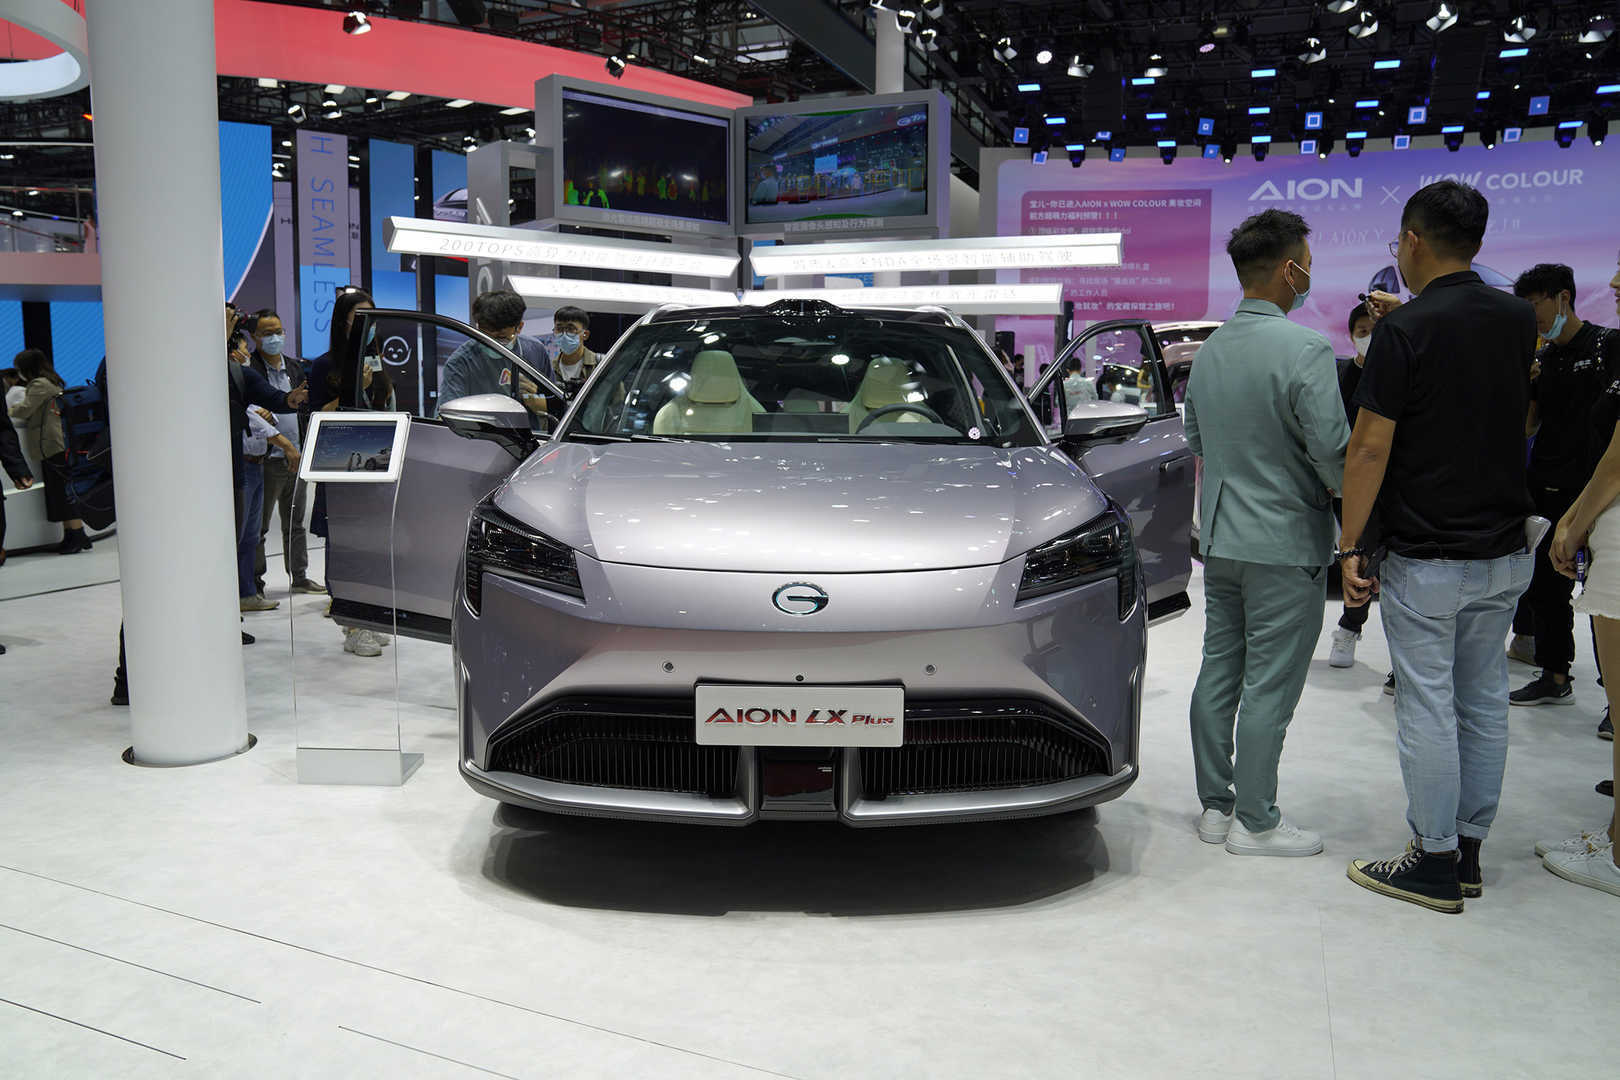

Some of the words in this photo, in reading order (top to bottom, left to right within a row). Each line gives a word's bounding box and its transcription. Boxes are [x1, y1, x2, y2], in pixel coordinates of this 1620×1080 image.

[1247, 177, 1363, 200] AION
[1485, 168, 1583, 190] COLOUR
[1132, 199, 1167, 208] COLOUR
[311, 177, 336, 333] SEAMLESS
[705, 707, 796, 724] AION
[804, 708, 848, 725] LX
[852, 714, 895, 726] Plus
